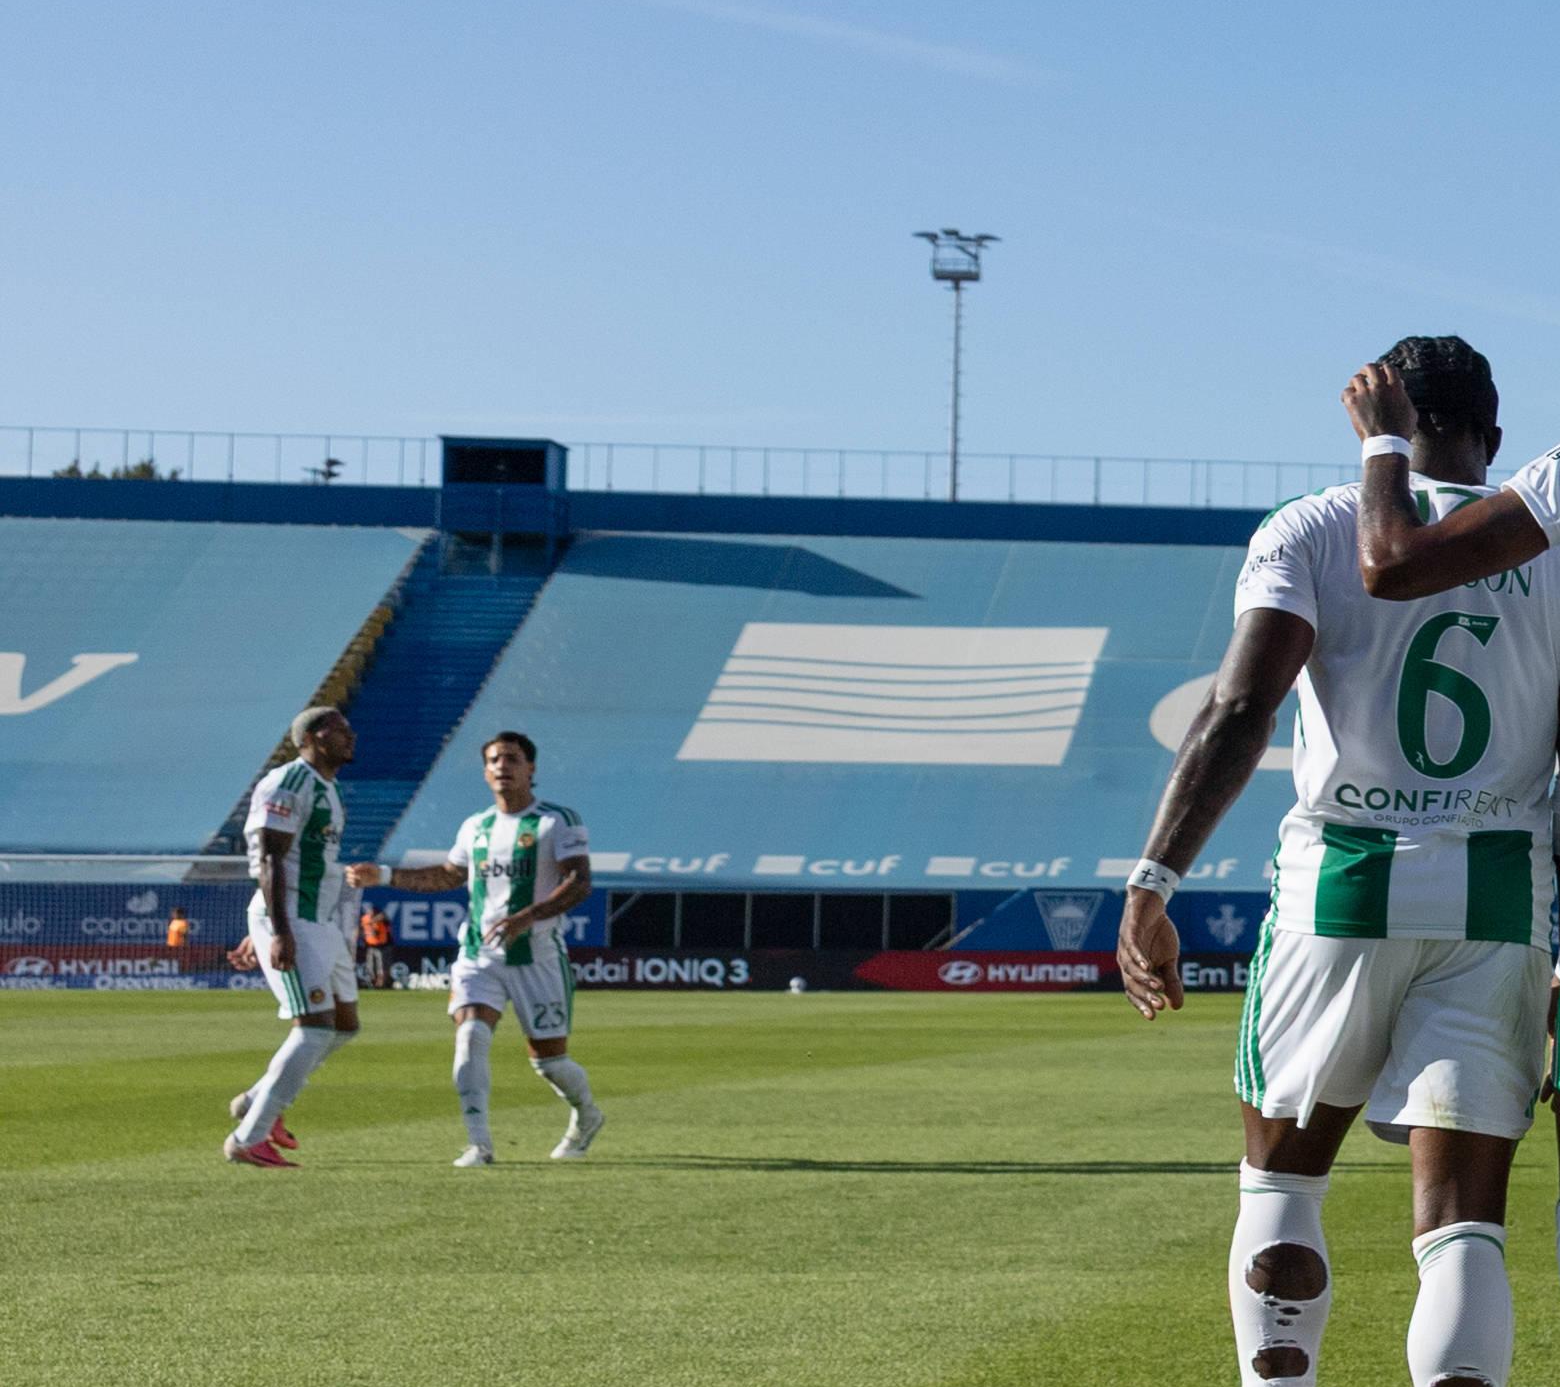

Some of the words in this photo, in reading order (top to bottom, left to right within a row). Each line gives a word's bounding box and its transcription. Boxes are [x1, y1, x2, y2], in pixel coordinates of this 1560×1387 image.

[1397, 611, 1501, 779] 6
[1335, 782, 1519, 820] CONFIRENT
[634, 853, 730, 874] cuf
[808, 855, 901, 876] cuf
[979, 857, 1071, 878] cuf
[635, 958, 725, 987] IONIQ
[1181, 961, 1231, 986] Em
[533, 1002, 564, 1029] 23
